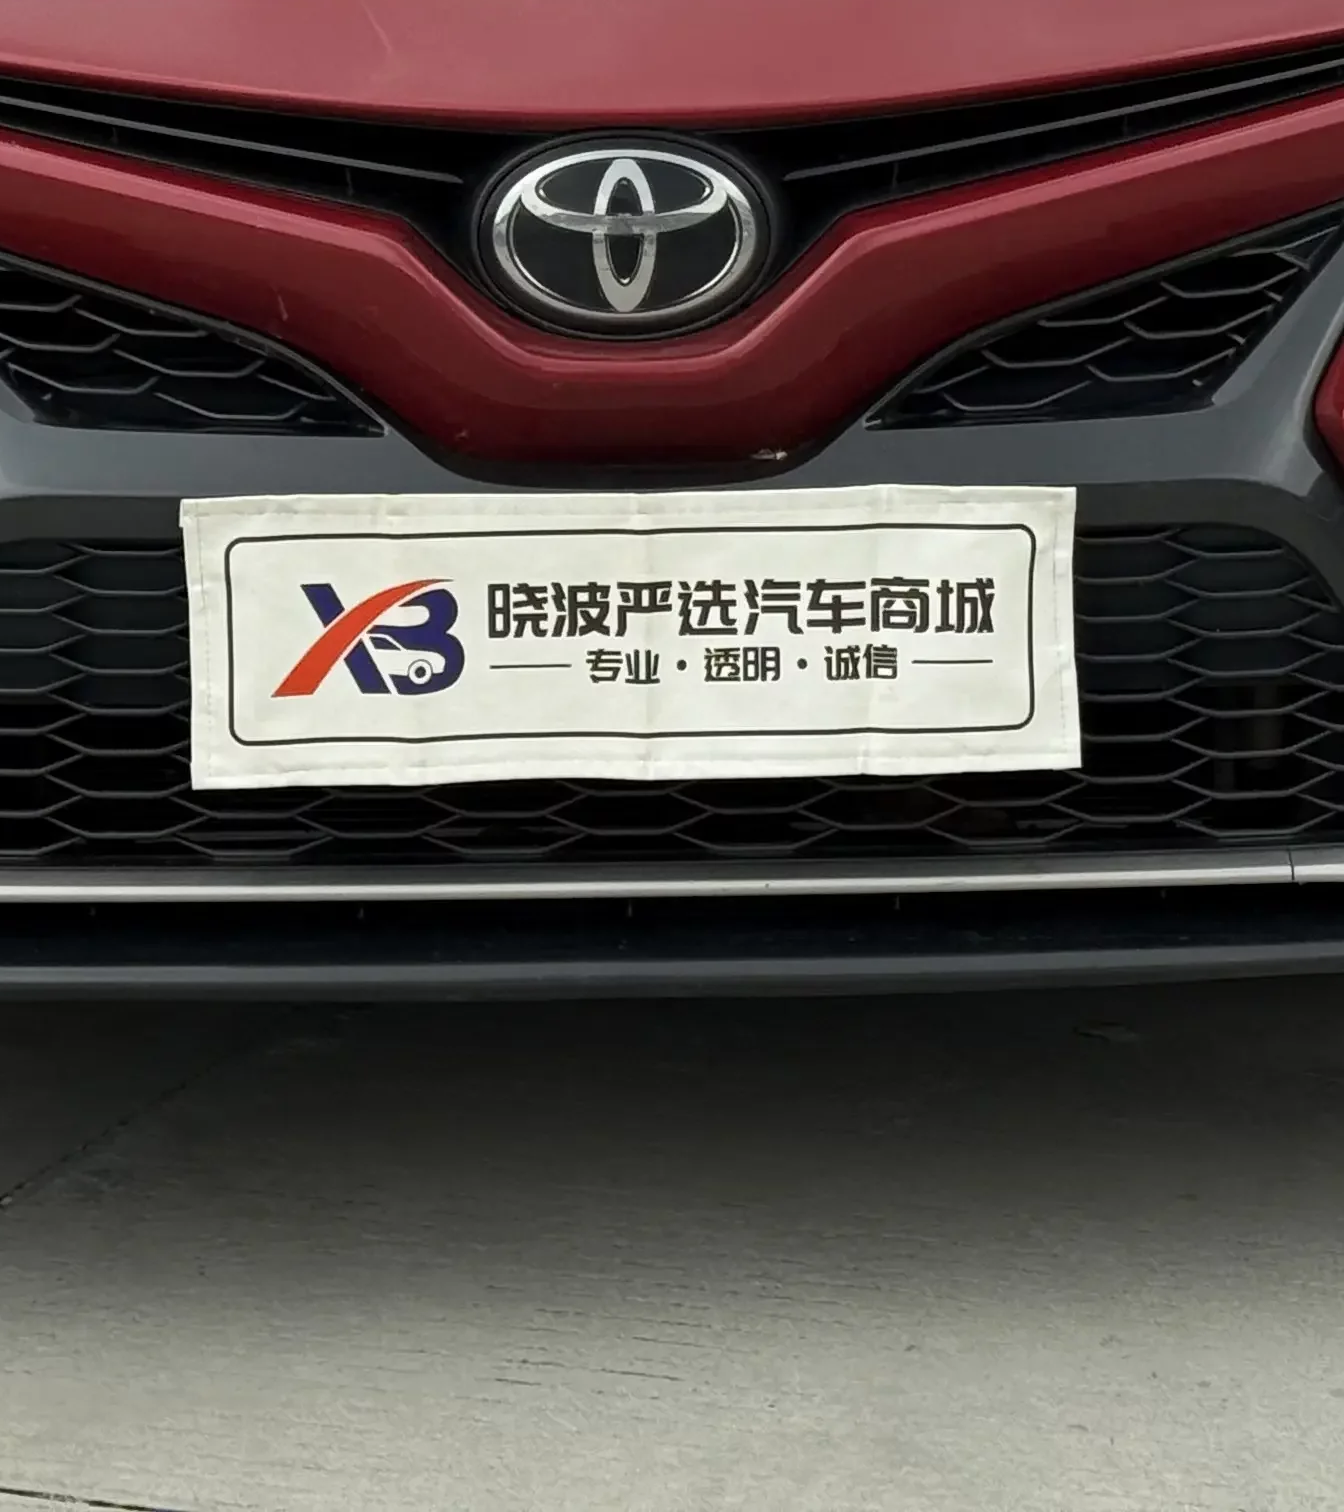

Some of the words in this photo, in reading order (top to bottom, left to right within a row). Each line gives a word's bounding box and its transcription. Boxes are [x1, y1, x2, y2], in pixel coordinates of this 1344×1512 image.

[487, 576, 995, 639] 晓波严选汽车商城
